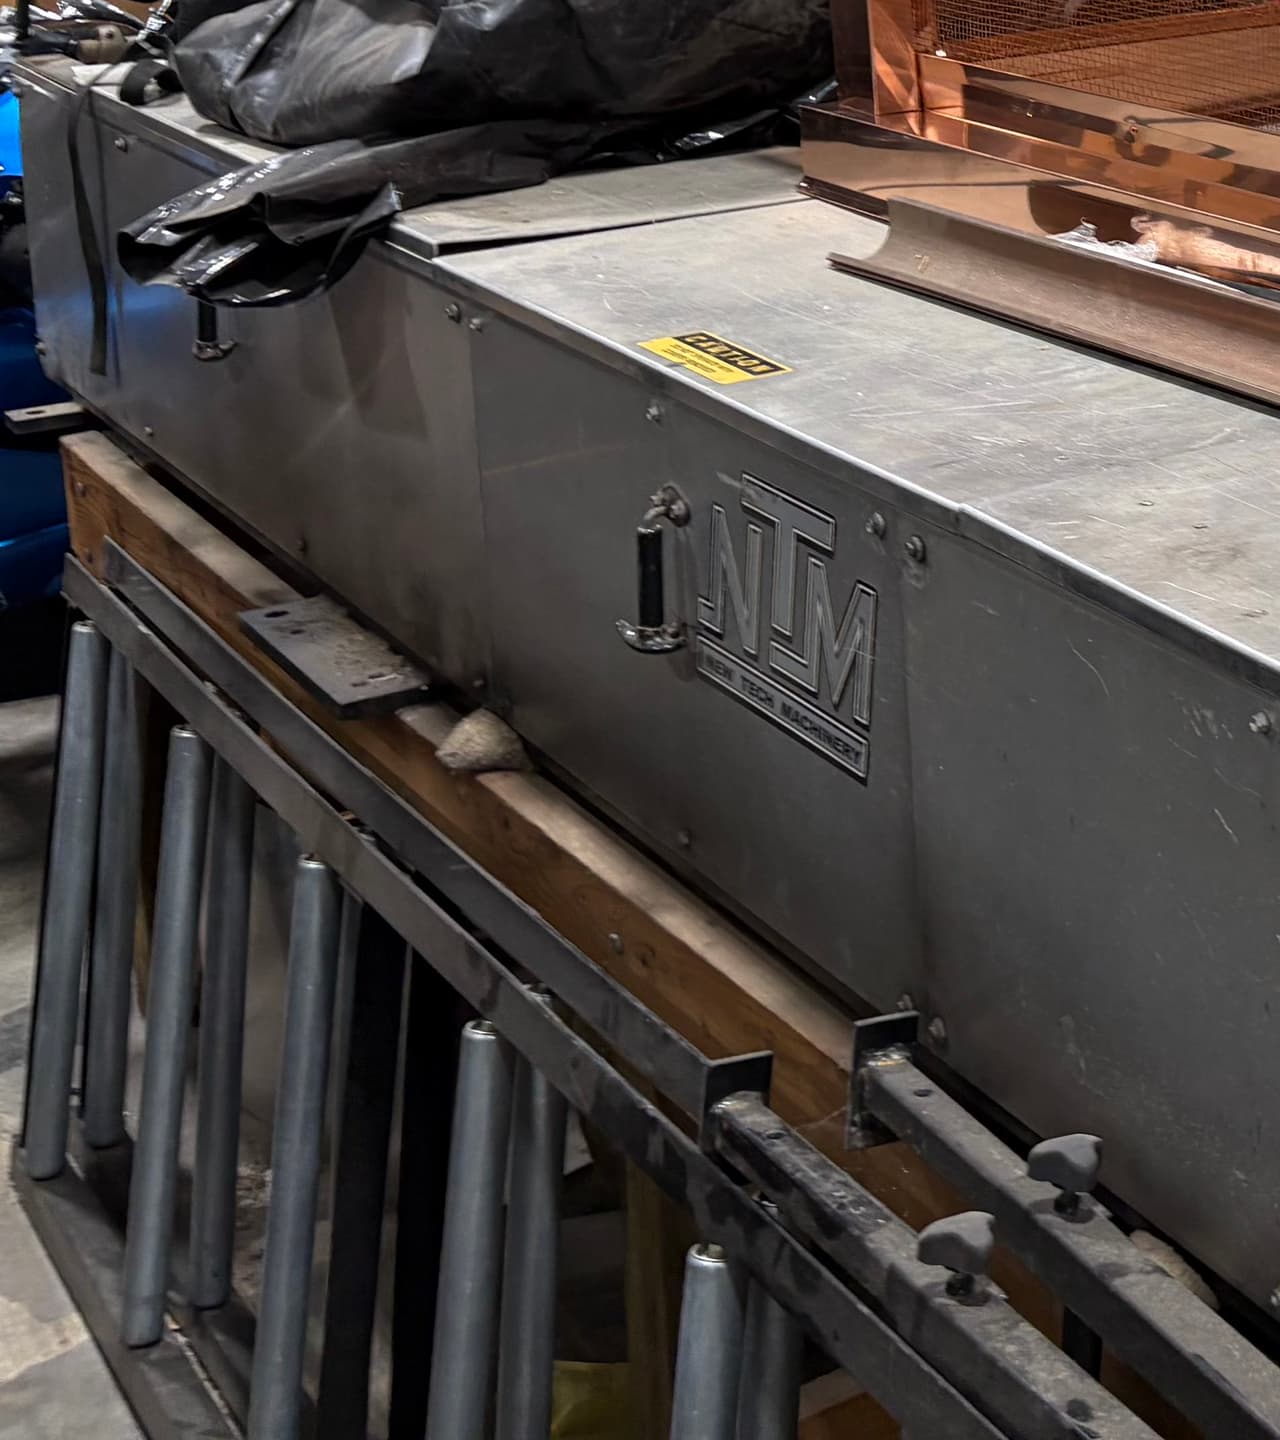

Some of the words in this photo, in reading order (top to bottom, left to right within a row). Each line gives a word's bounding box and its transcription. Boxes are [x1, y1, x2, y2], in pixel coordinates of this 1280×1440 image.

[685, 335, 775, 372] CAUTION
[697, 471, 878, 731] NTM
[706, 655, 733, 681] NEW
[741, 675, 775, 709] TECH
[781, 701, 862, 764] MACHINERY
